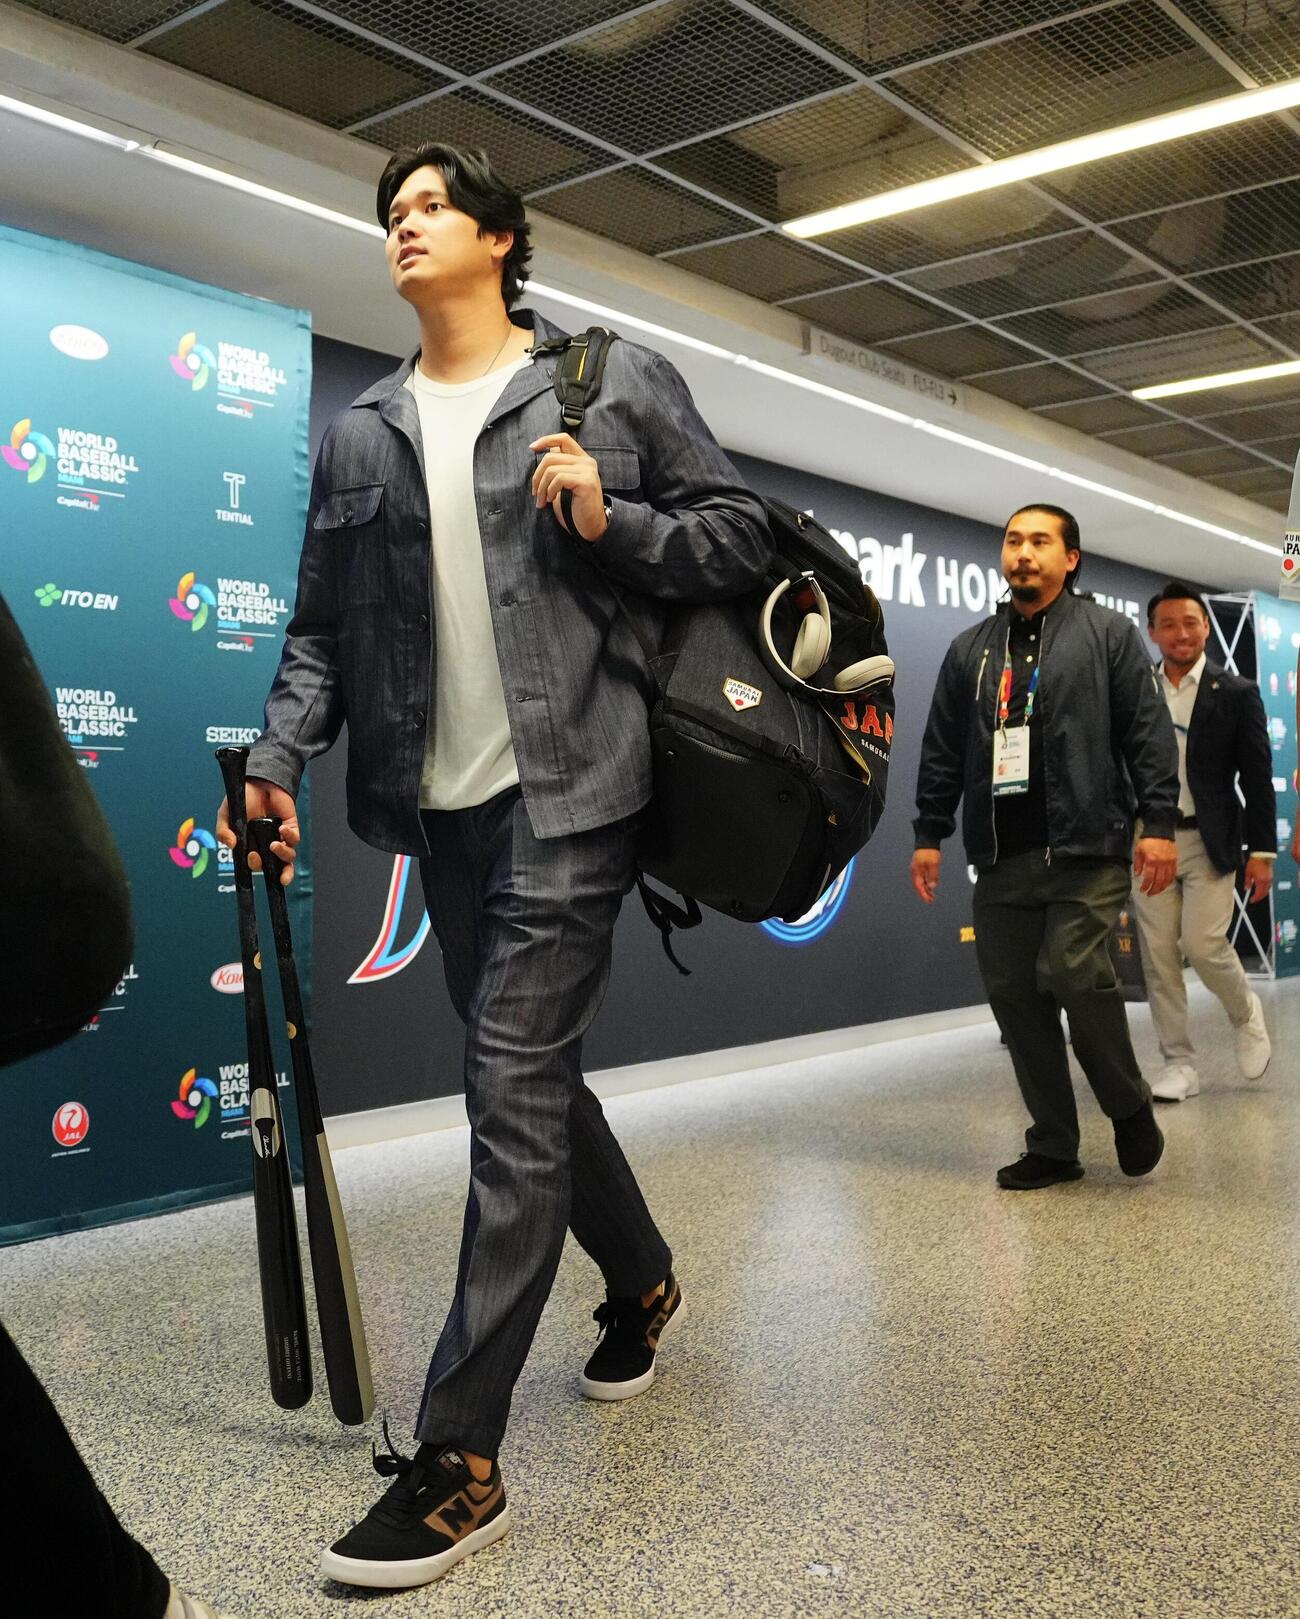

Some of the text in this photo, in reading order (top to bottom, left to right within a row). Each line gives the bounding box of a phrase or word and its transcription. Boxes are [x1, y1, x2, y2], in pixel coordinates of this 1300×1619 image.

[217, 341, 270, 366] WORLD
[217, 355, 287, 385] BASEBALL
[217, 369, 276, 395] CLASSIC
[57, 427, 117, 453] WORLD
[57, 442, 139, 472] BASEBALL
[56, 458, 126, 484] CLASSIC
[215, 509, 254, 525] TENTIAL
[217, 578, 269, 597] WORLD
[937, 555, 1011, 616] HOM
[217, 592, 289, 613] BASEBALL
[217, 606, 277, 625] CLASSIC
[56, 687, 116, 706] WORLD
[726, 686, 758, 703] JAPAN
[728, 681, 760, 696] SAMURAI
[56, 703, 138, 722] BASEBALL
[206, 726, 262, 743] SEIKO
[62, 1131, 82, 1142] JAL
